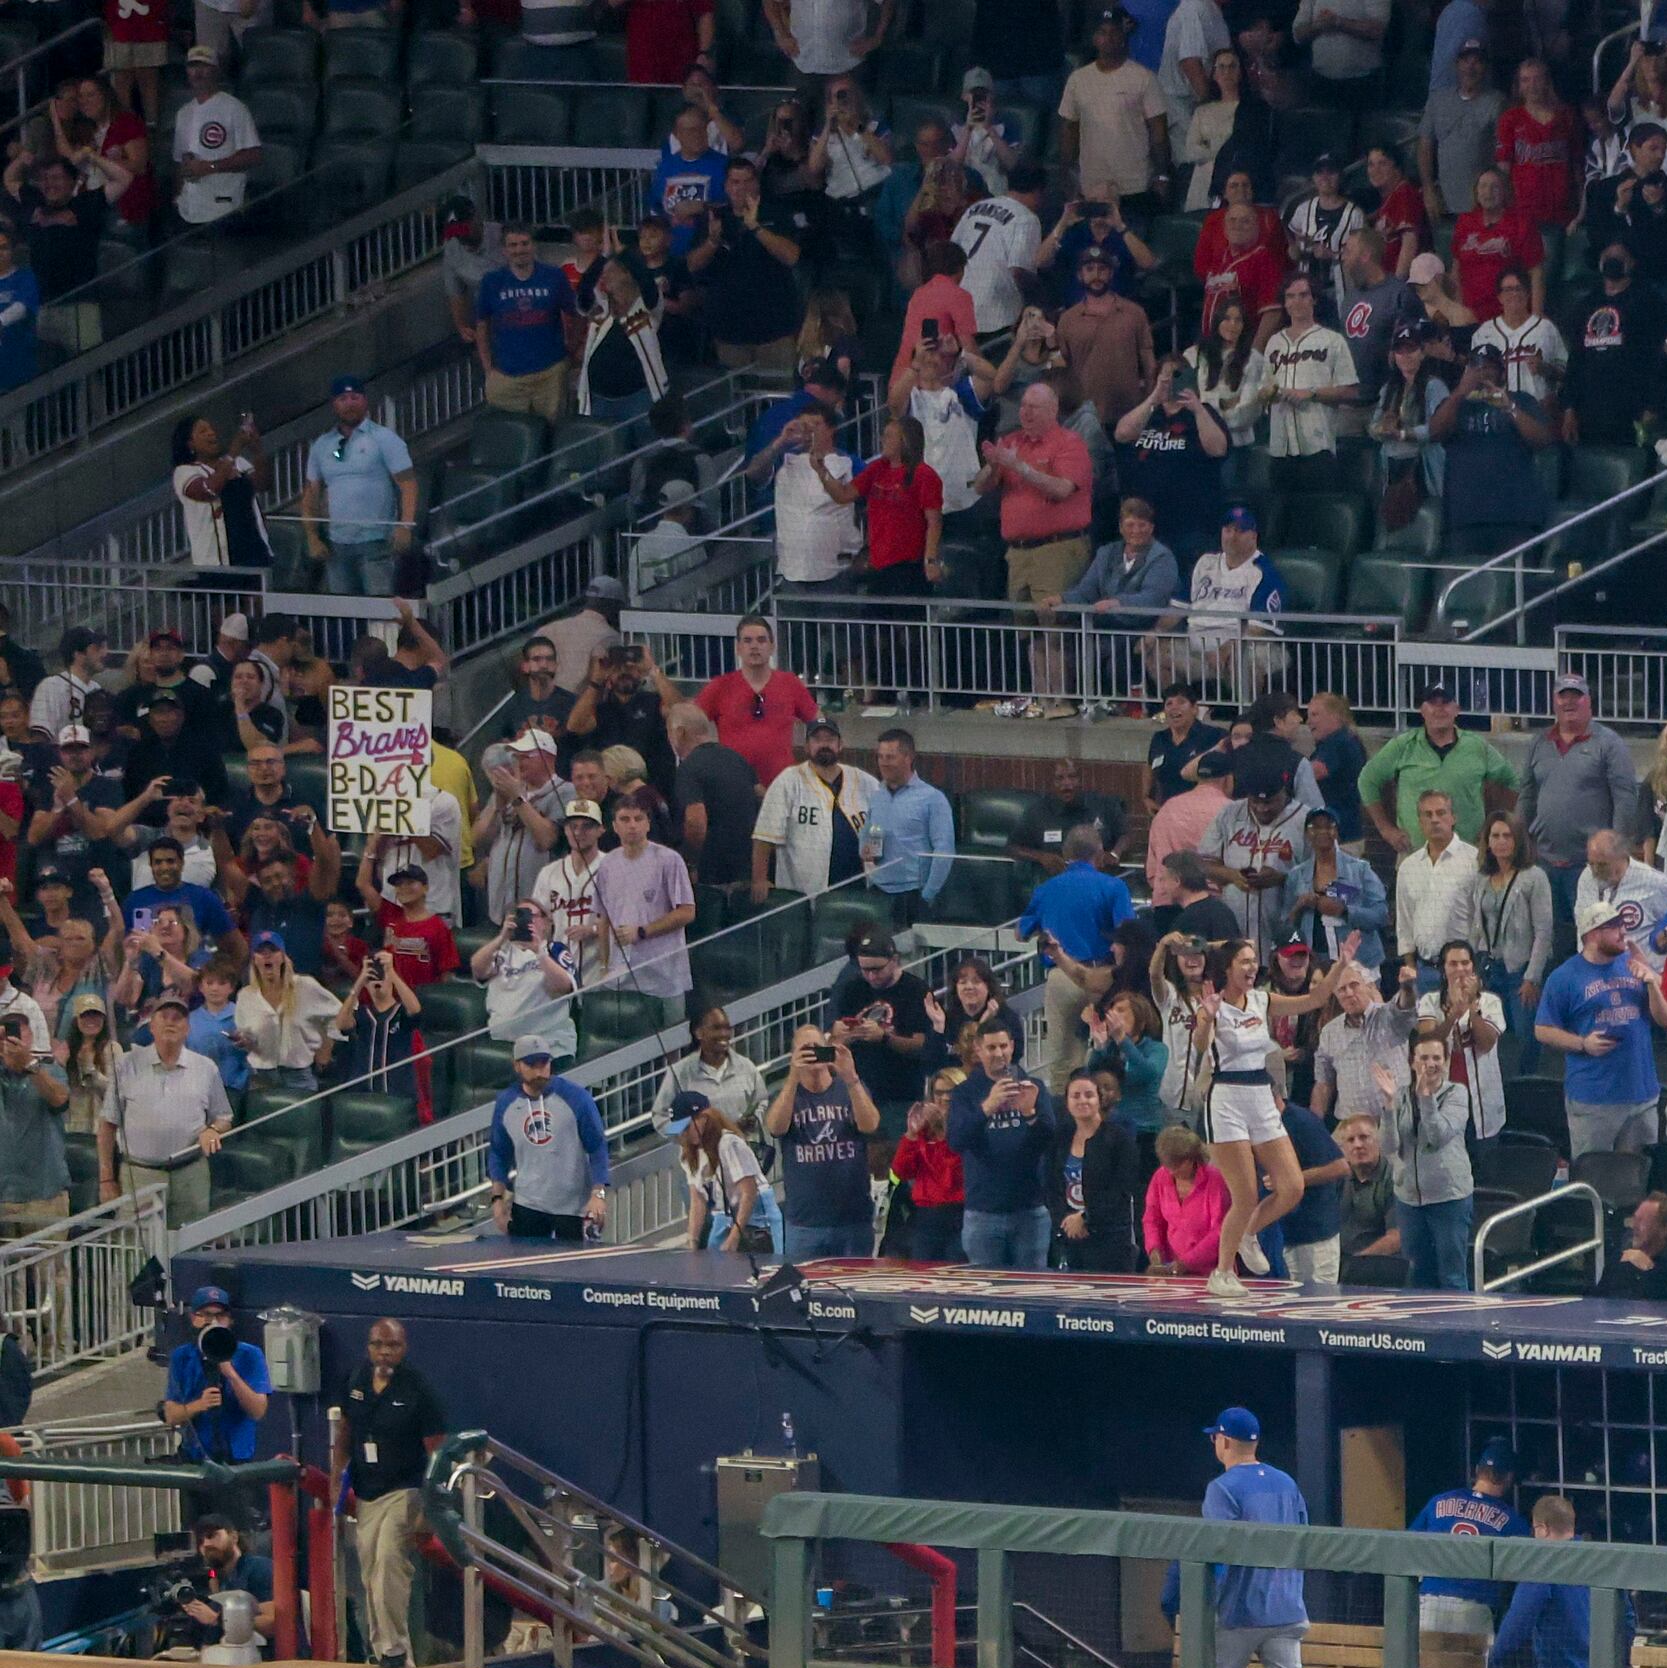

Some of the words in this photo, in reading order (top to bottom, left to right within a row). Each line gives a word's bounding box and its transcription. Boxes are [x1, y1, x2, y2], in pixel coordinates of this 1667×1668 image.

[968, 222, 991, 261] 7
[1135, 439, 1186, 451] FUTURE
[332, 689, 415, 722] BEST
[332, 722, 432, 760] Braves
[330, 764, 432, 799] B-DAY
[333, 800, 415, 835] EVER
[796, 1141, 855, 1163] BRAVES
[383, 1275, 465, 1296] YANMAR
[494, 1282, 552, 1301] Tractors
[583, 1288, 645, 1307] Compact
[647, 1290, 720, 1311] Equipment
[943, 1308, 1025, 1329] YANMAR
[1056, 1314, 1114, 1333] Tractors
[1146, 1319, 1209, 1340] Compact
[1211, 1322, 1285, 1344] Equipment
[1318, 1329, 1426, 1353] YanmarUS.com
[1514, 1342, 1602, 1364] YANMAR
[1435, 1497, 1510, 1532] HOERNER
